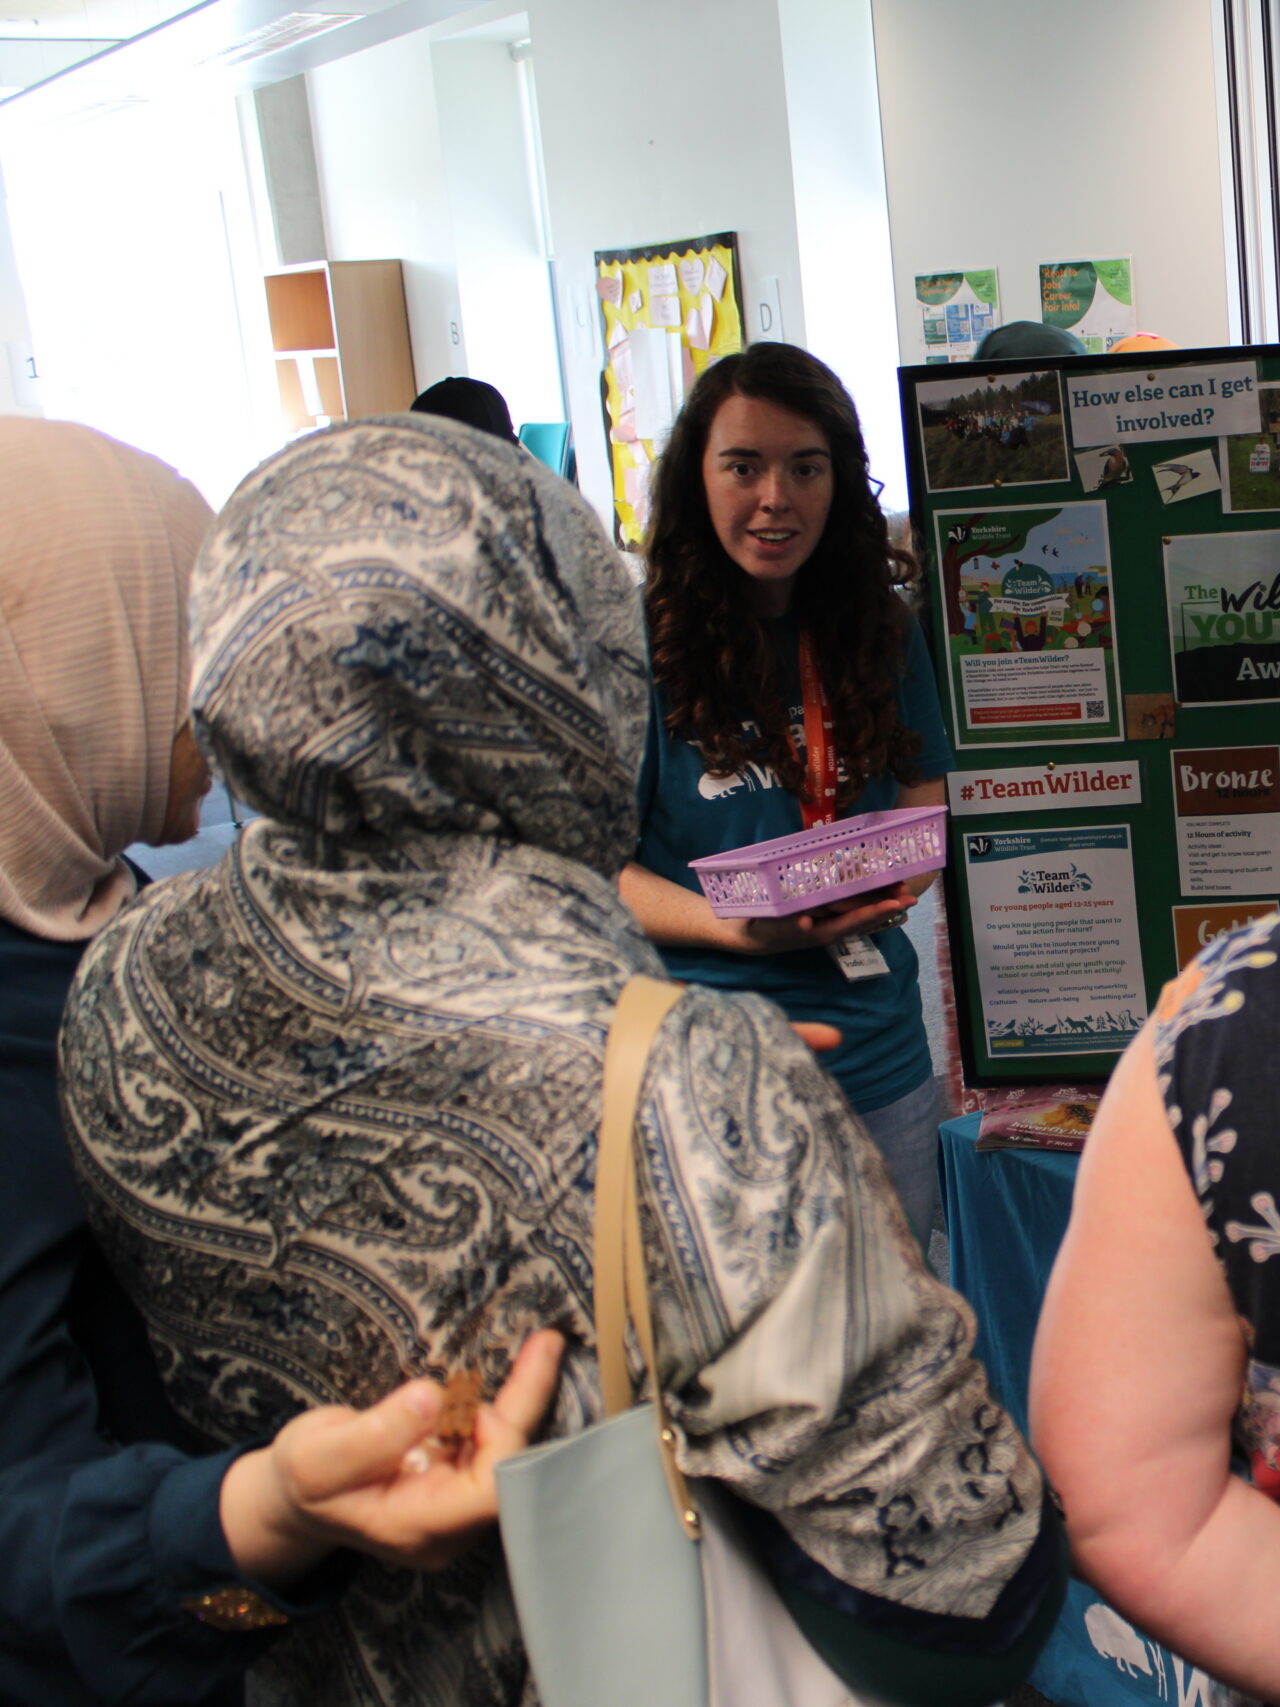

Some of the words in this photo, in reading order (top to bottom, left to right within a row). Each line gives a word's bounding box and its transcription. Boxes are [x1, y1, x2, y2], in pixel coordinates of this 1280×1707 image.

[1072, 390, 1120, 408] How
[1124, 384, 1164, 402] else
[1168, 383, 1204, 399] can
[1208, 378, 1217, 395] I
[1221, 376, 1253, 399] get
[1116, 407, 1215, 433] involved?
[1016, 579, 1038, 587] Team
[1014, 587, 1041, 595] Wilder
[1184, 585, 1218, 600] The
[965, 659, 981, 667] Will
[982, 659, 997, 668] you
[998, 657, 1013, 666] join
[1180, 764, 1274, 792] Bronze
[960, 770, 1132, 800] #TeamWilder
[1225, 830, 1251, 838] activity
[994, 837, 1031, 846] Yorkshire
[1036, 870, 1070, 881] Team
[1033, 882, 1076, 894] Wilder
[990, 904, 1003, 912] For
[1004, 903, 1028, 913] young
[1029, 901, 1053, 911] people
[1055, 900, 1072, 910] aged
[1074, 900, 1092, 908] 13-25
[1093, 899, 1114, 908] years
[1032, 920, 1054, 929] young
[1055, 918, 1078, 927] people
[1079, 917, 1093, 925] that
[1016, 928, 1031, 936] take
[1032, 927, 1054, 935] action
[1055, 926, 1065, 934] for
[1066, 925, 1093, 934] nature?
[992, 943, 1014, 951] Would
[1015, 943, 1029, 951] you
[1030, 941, 1042, 949] like
[1052, 940, 1077, 948] involve
[1098, 938, 1120, 947] young
[1013, 949, 1036, 958] people
[1069, 946, 1100, 955] projects?
[1066, 961, 1082, 969] your
[1083, 959, 1103, 968] youth
[997, 971, 1019, 979] school
[1030, 969, 1054, 978] college
[1056, 968, 1069, 976] and
[1011, 1121, 1067, 1134] hoverfly
